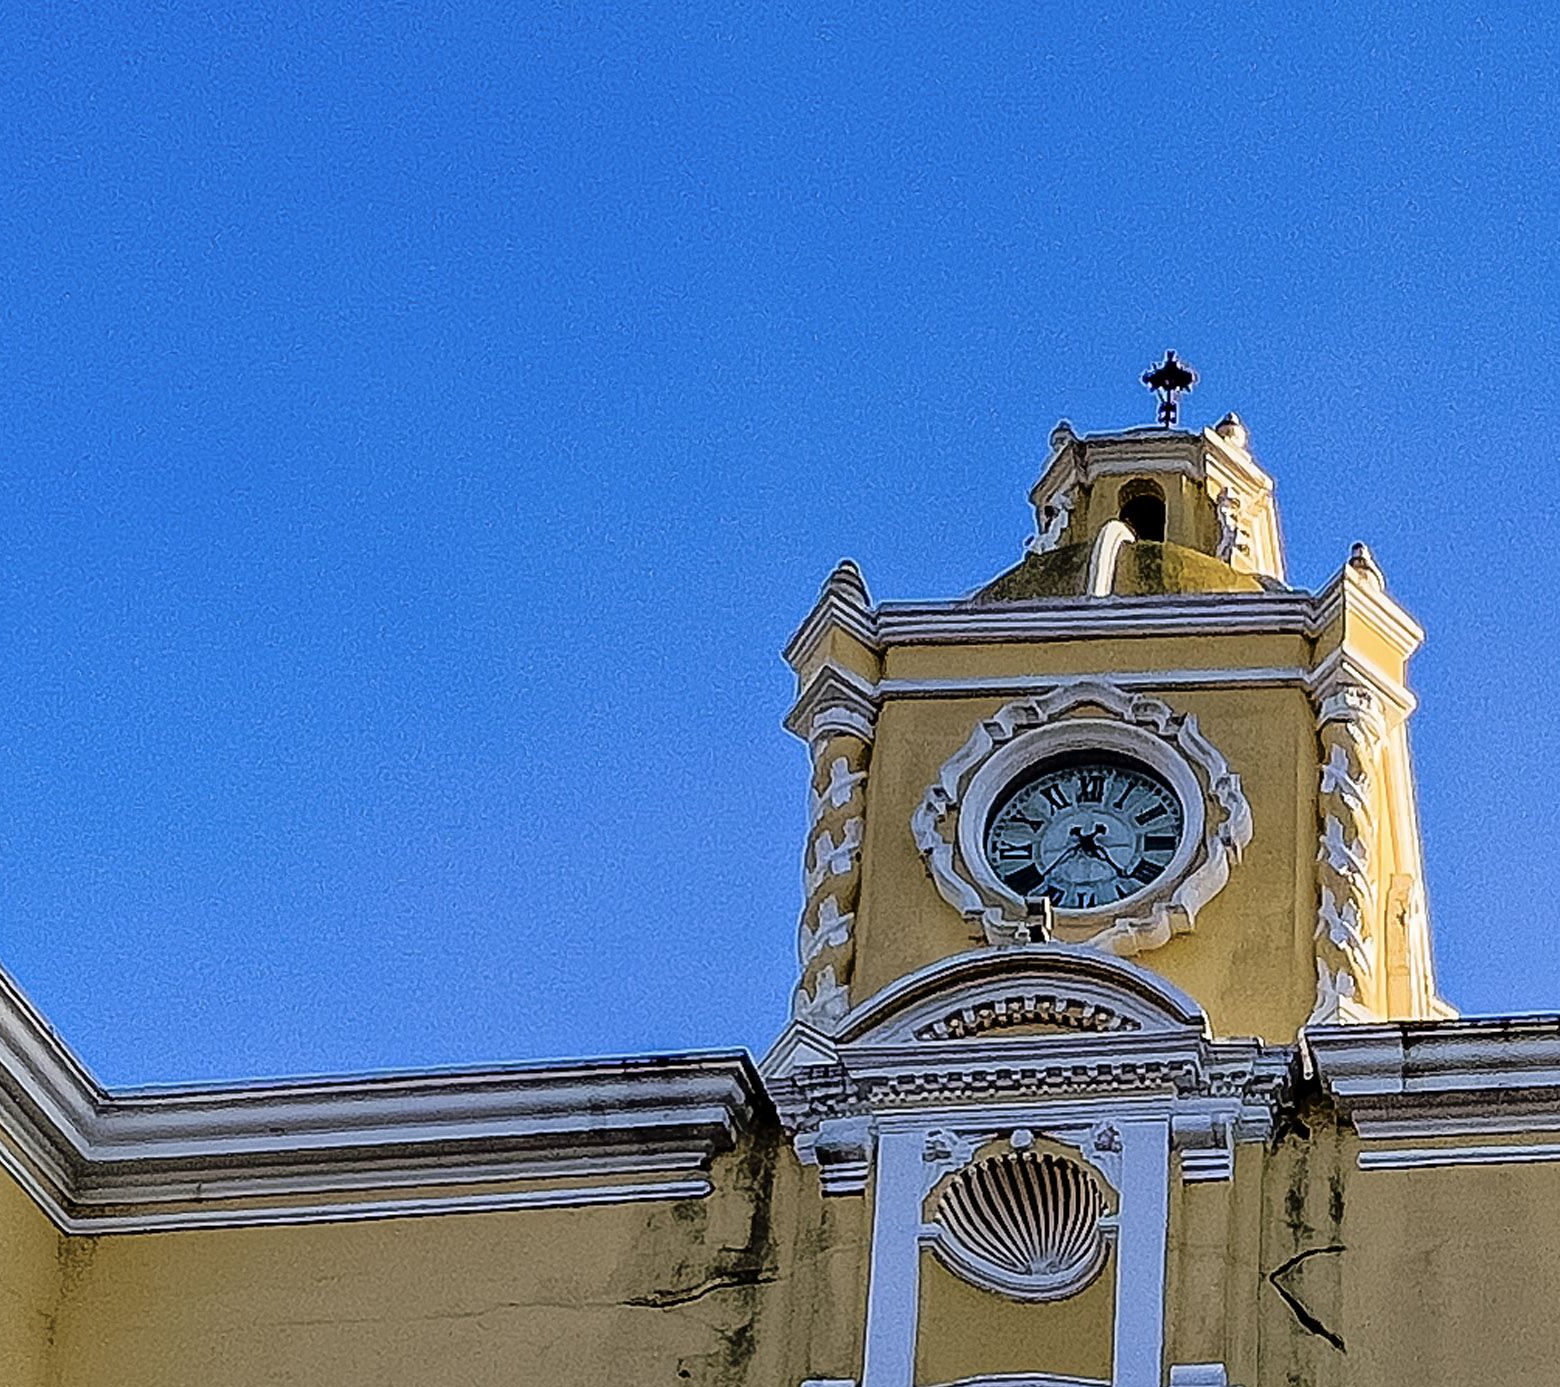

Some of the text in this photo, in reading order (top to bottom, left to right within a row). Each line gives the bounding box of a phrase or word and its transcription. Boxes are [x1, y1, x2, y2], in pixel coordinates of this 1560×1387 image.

[1040, 783, 1072, 815] XI
[1077, 776, 1105, 802] XII
[1135, 802, 1167, 826] II
[1000, 841, 1032, 859] IX
